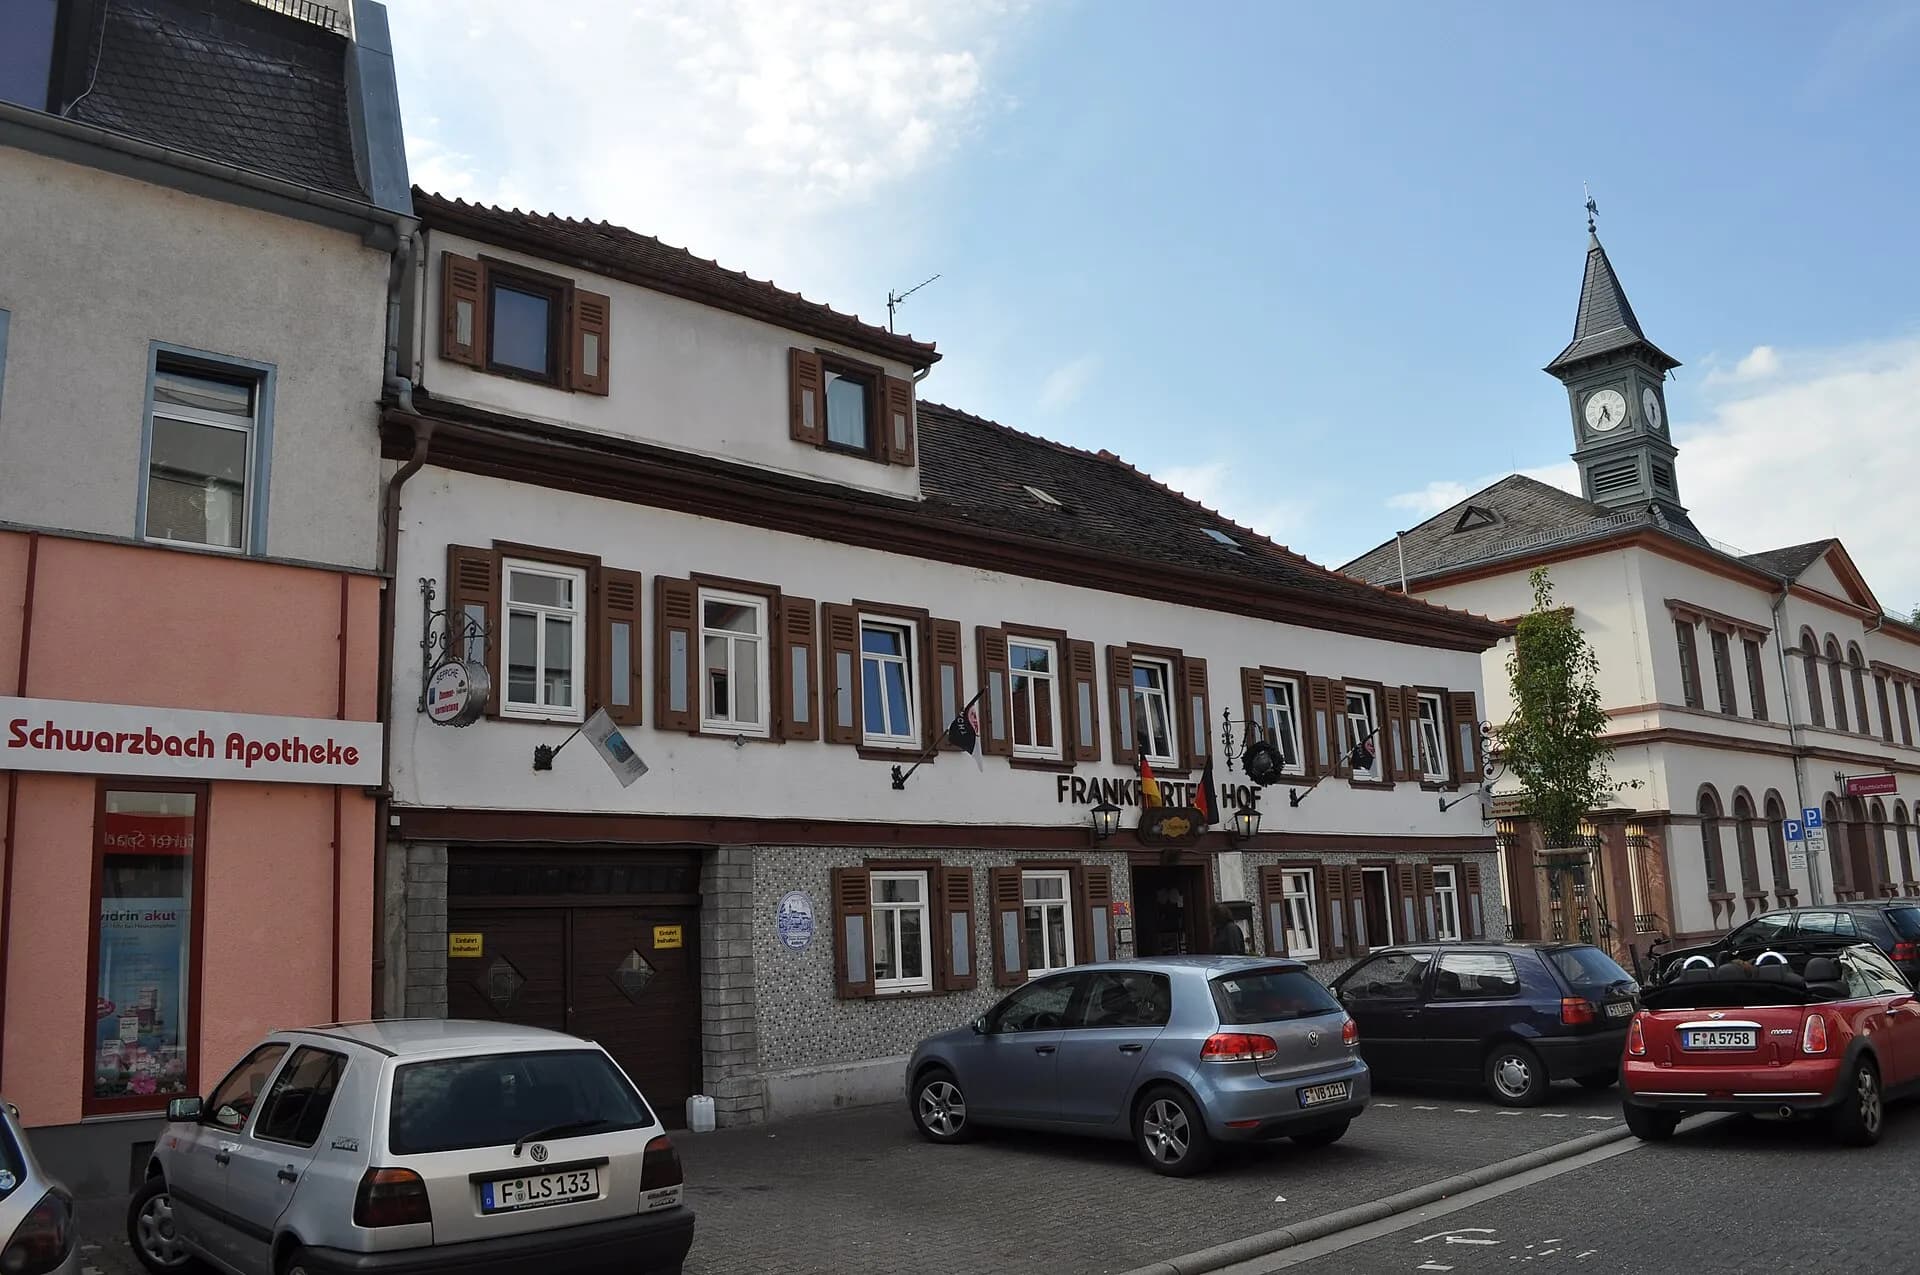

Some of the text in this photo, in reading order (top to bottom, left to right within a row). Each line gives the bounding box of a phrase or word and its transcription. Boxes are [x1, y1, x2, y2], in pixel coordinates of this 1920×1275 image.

[7, 718, 360, 769] Schwarzbach Apotheke
[1056, 774, 1262, 810] FRANKFRTE HOF
[1806, 810, 1817, 826] P
[1787, 822, 1798, 839] P
[144, 910, 176, 921] akut
[1693, 1032, 1701, 1045] F
[1719, 1032, 1750, 1045] 5758
[1327, 1083, 1346, 1098] 1211
[501, 1182, 514, 1204] F
[527, 1177, 552, 1200] LS
[556, 1172, 590, 1196] 133
